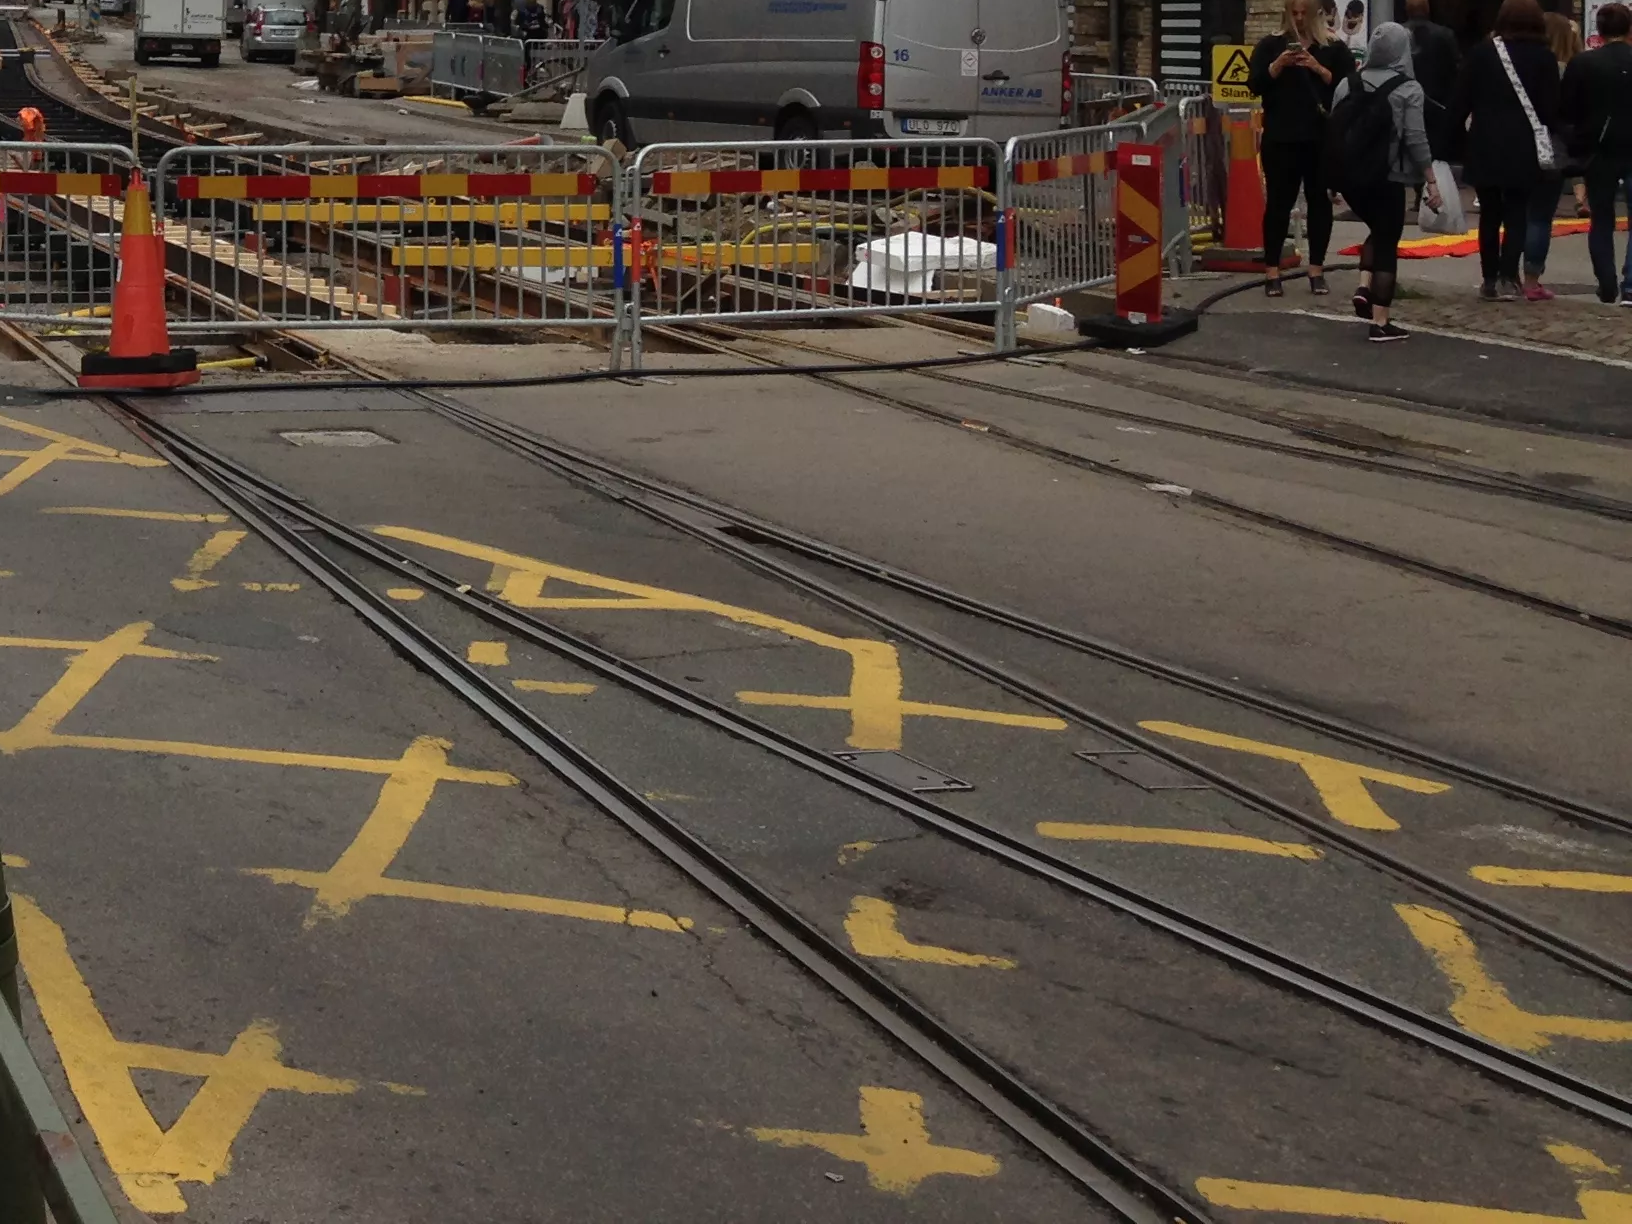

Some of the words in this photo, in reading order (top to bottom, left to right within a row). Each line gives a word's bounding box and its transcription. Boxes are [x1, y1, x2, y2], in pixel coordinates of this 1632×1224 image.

[893, 48, 910, 62] 16
[981, 87, 1024, 98] ANKER
[1026, 87, 1043, 98] AB
